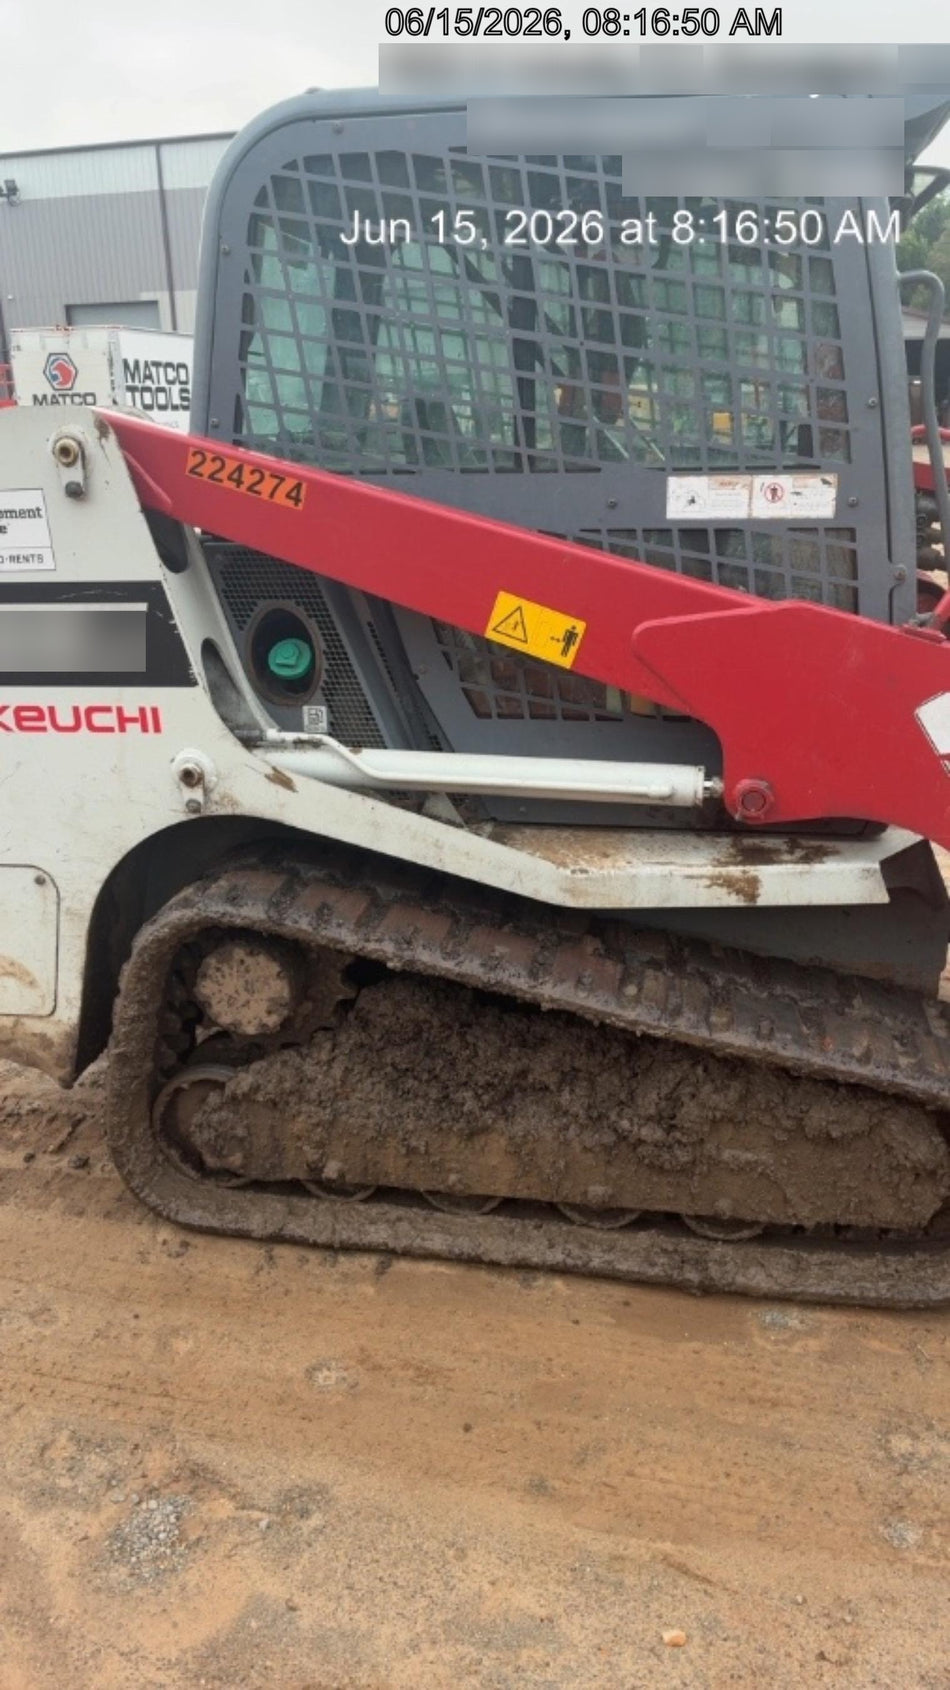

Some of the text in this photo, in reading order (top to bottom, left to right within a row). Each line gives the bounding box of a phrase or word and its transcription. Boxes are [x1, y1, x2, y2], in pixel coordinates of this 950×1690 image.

[122, 358, 189, 385] MATCO
[32, 392, 97, 406] MATCO
[125, 385, 190, 411] TOOLS
[187, 449, 304, 507] 224274
